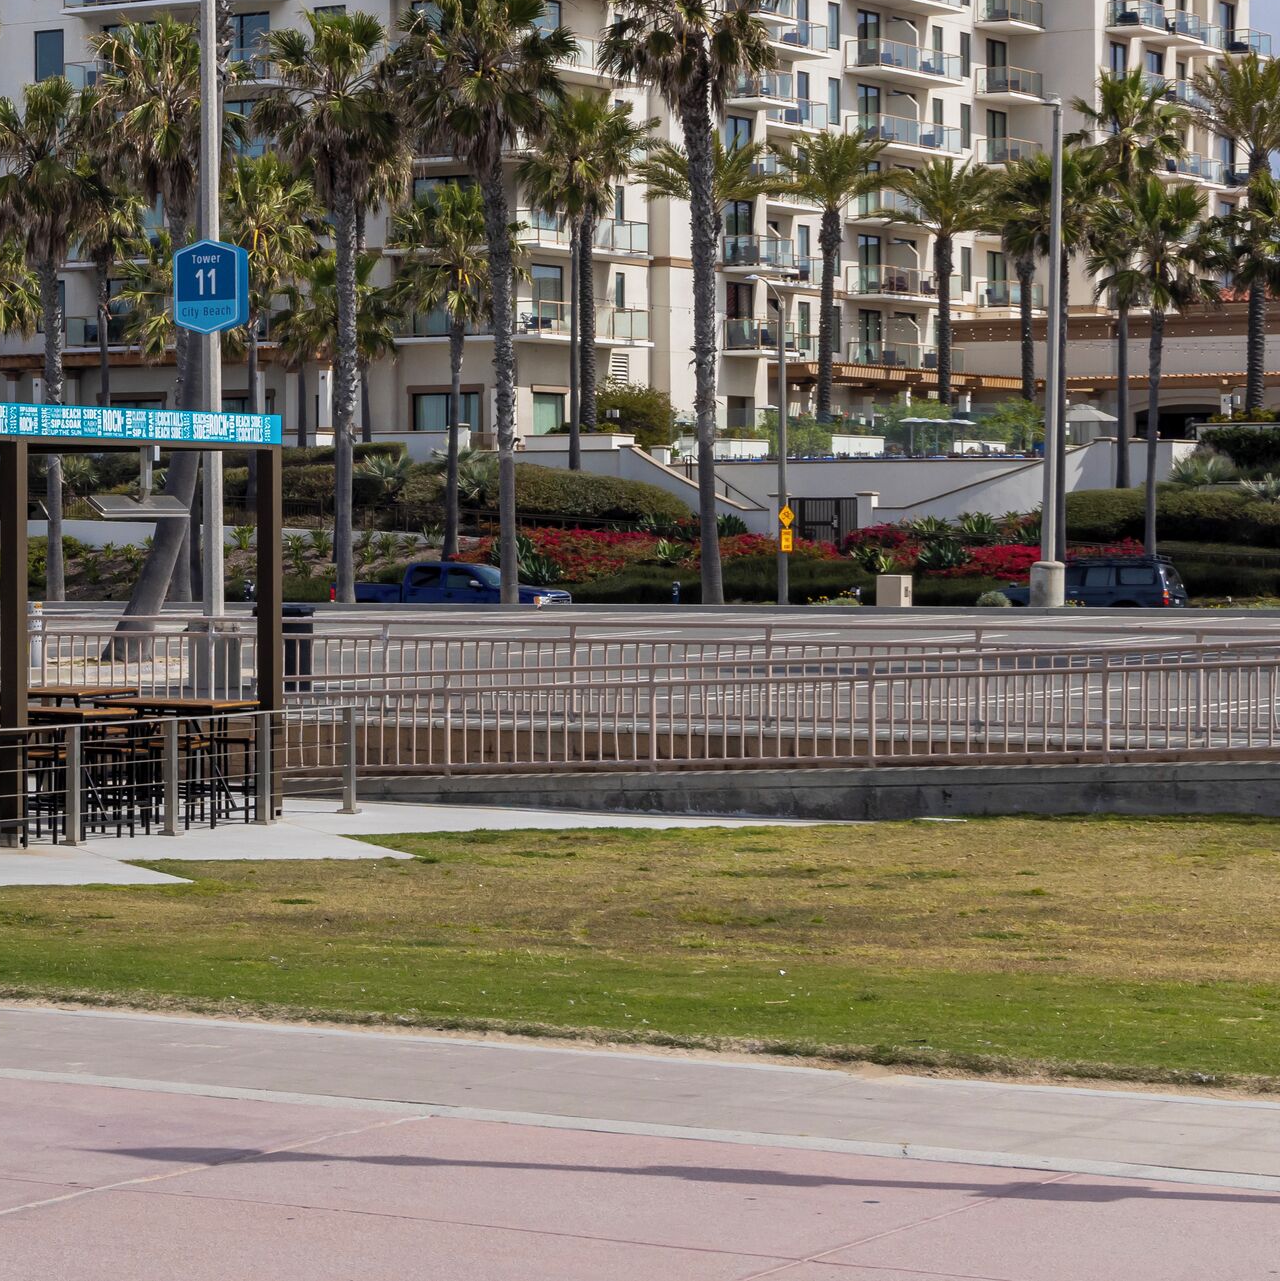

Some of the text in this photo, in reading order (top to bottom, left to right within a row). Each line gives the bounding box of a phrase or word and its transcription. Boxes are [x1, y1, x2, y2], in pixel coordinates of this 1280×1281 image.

[192, 254, 221, 264] Tower
[195, 268, 216, 296] 11
[182, 305, 231, 319] City Beach
[62, 408, 97, 419] BEACH SIDE
[103, 410, 122, 432] ROCK
